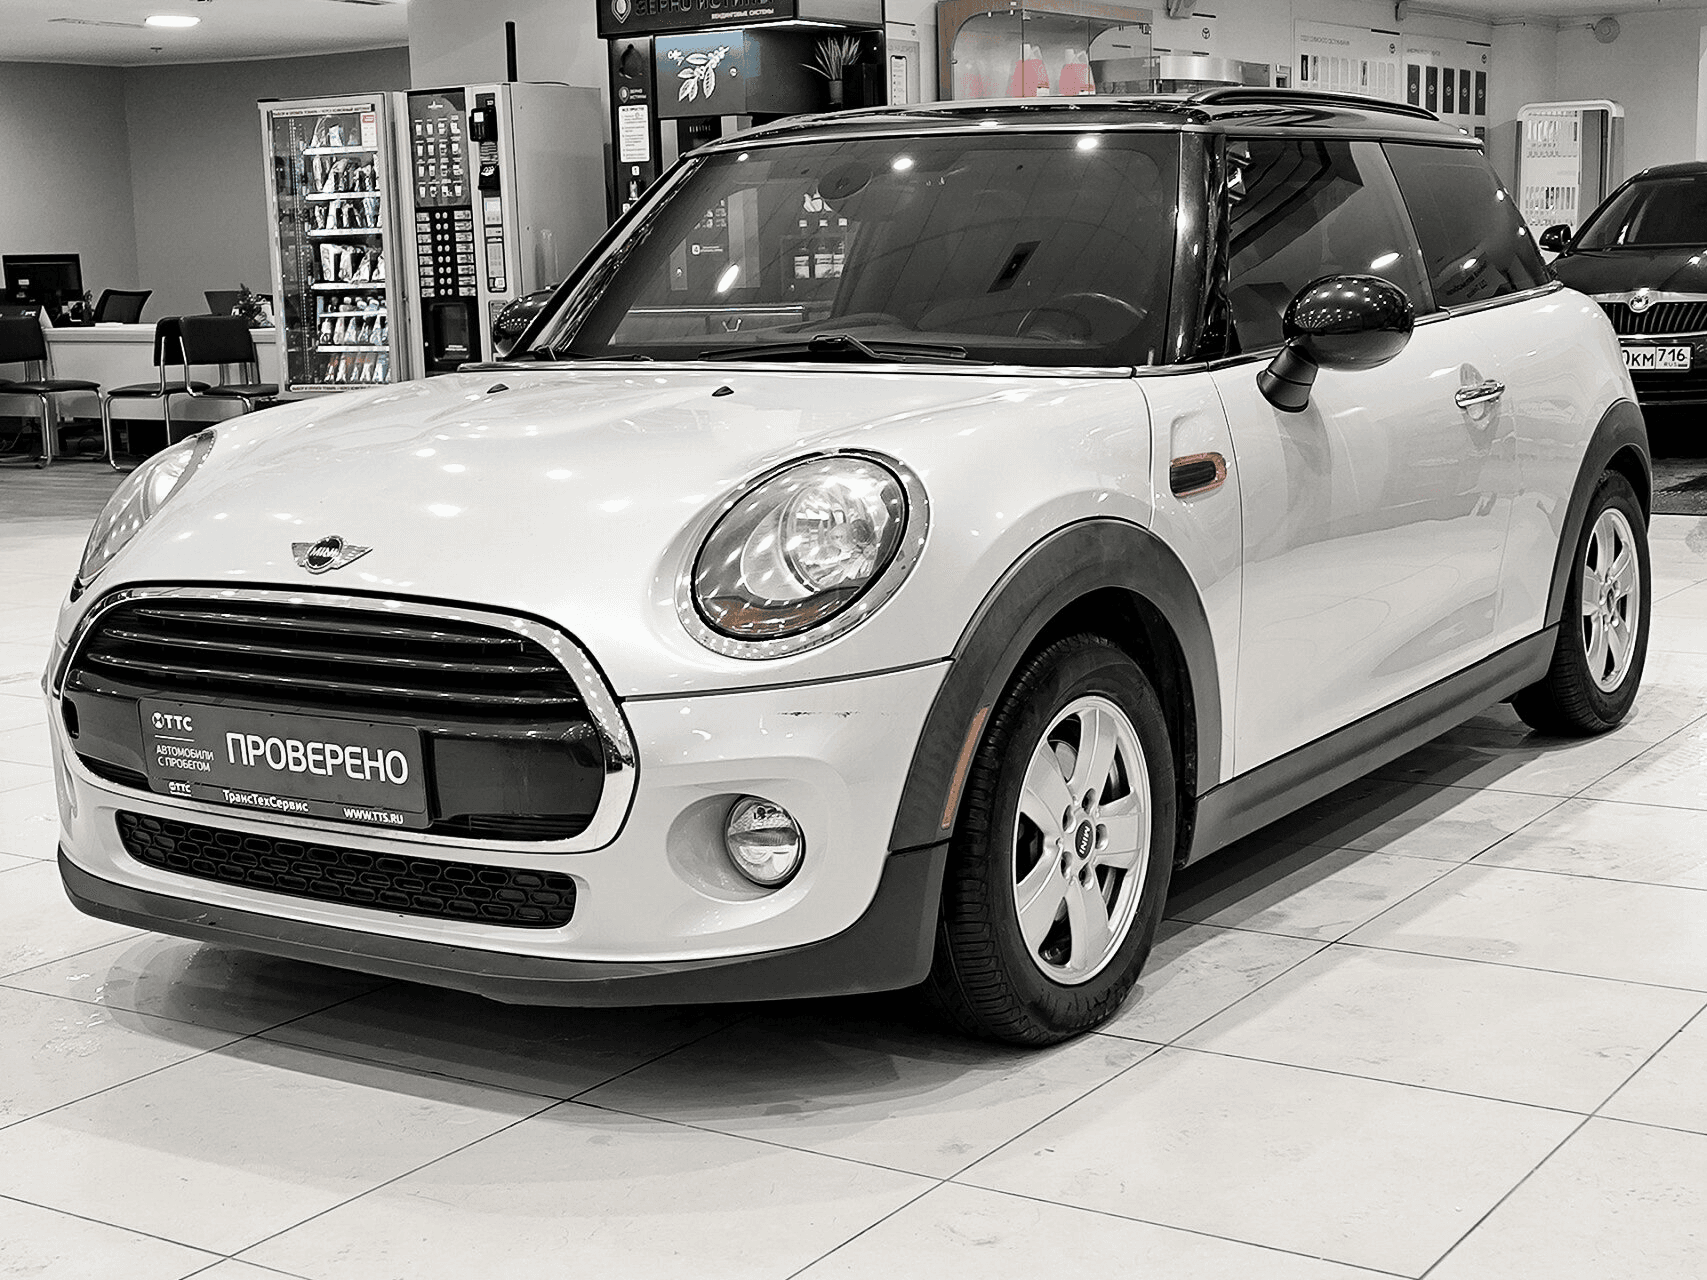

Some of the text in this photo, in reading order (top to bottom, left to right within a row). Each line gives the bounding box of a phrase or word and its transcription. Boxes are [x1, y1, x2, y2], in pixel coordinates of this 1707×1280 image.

[1658, 348, 1685, 362] 716
[156, 744, 215, 761] АВТОМОБИЛИ
[225, 731, 409, 785] ПРОВЕРЕНО
[157, 756, 211, 772] С ПРОБЕГОМ
[222, 789, 309, 813] ТрансТехСервис
[343, 807, 404, 825] WWW.TTS.RU
[1079, 825, 1091, 855] MINI
